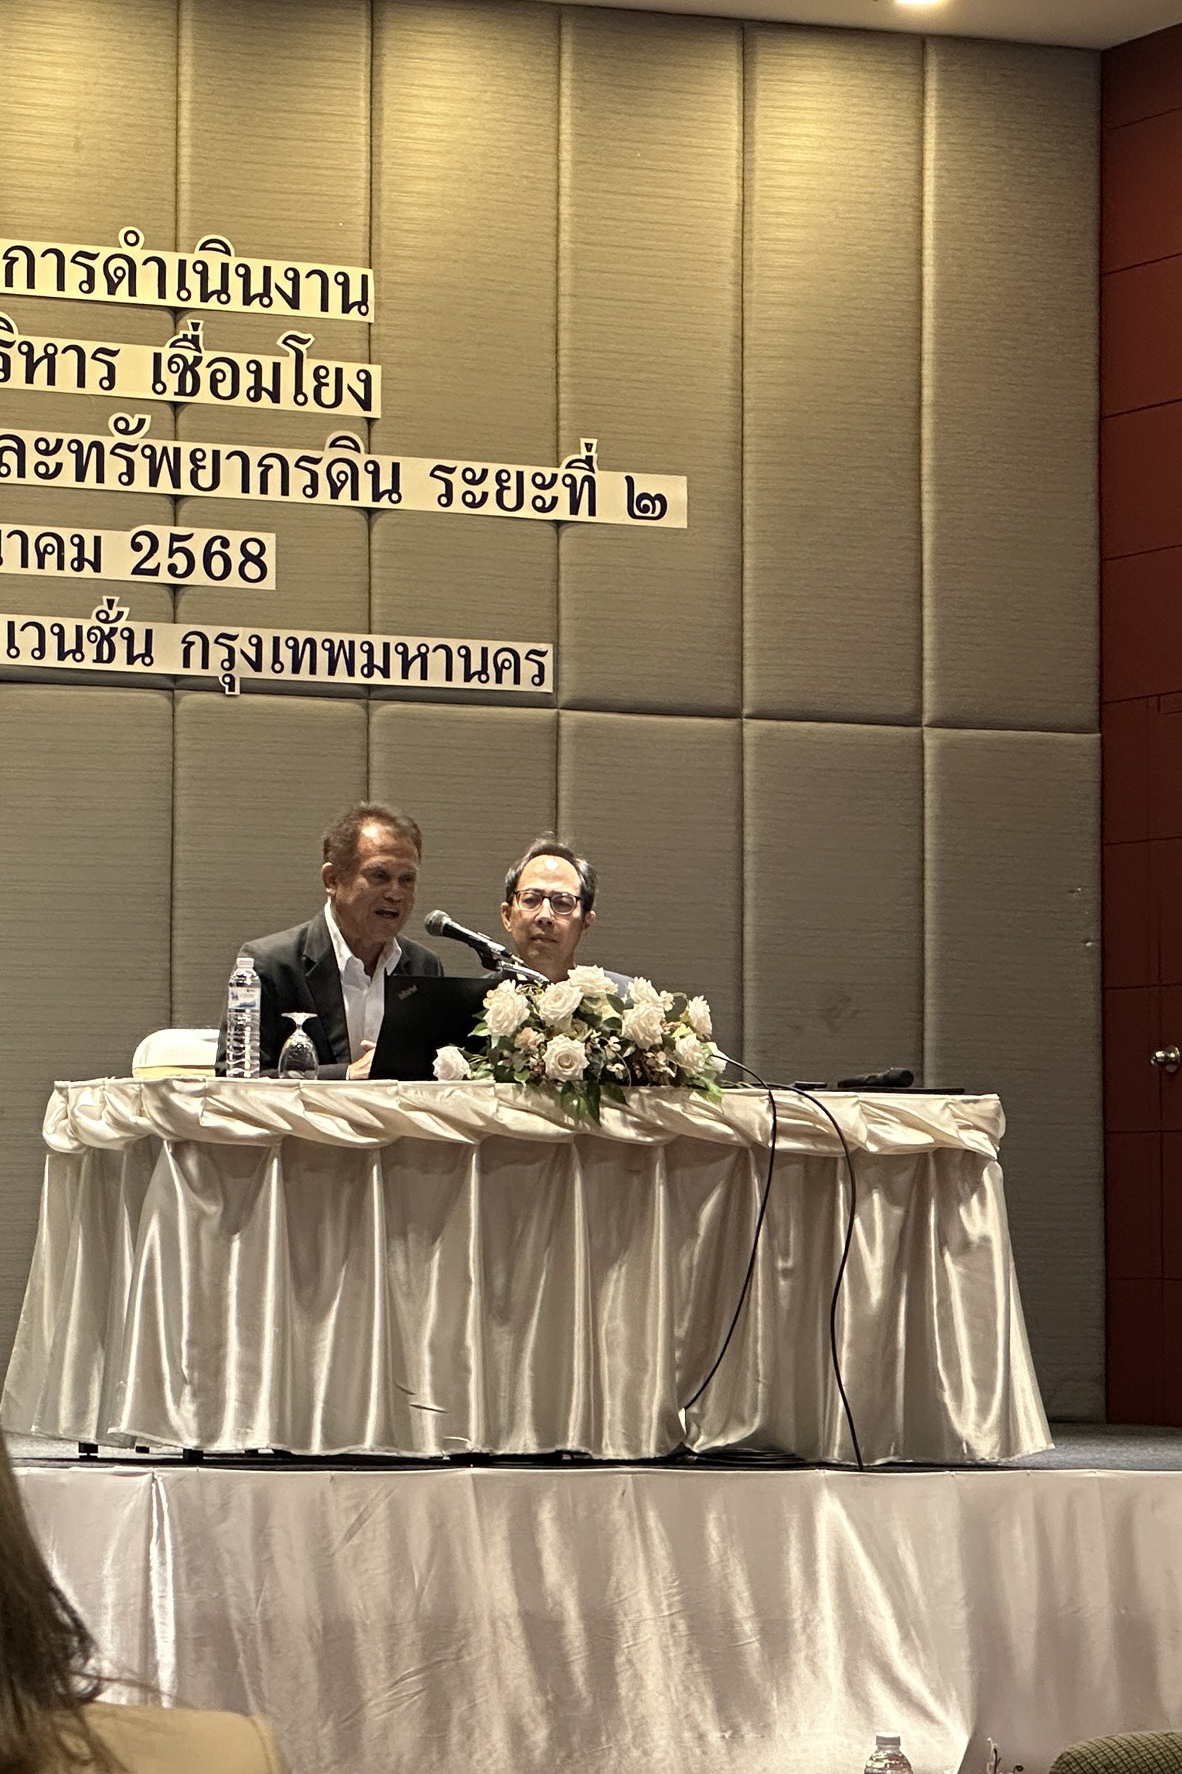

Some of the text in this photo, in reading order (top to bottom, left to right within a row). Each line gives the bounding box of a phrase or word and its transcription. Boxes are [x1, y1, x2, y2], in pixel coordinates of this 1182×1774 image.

[150, 321, 373, 413] เชื่อมโยง
[429, 440, 599, 518] ระยะที่
[624, 474, 668, 520] ๒
[129, 530, 269, 583] 2568
[181, 630, 549, 692] กรุงเทพมหานคร
